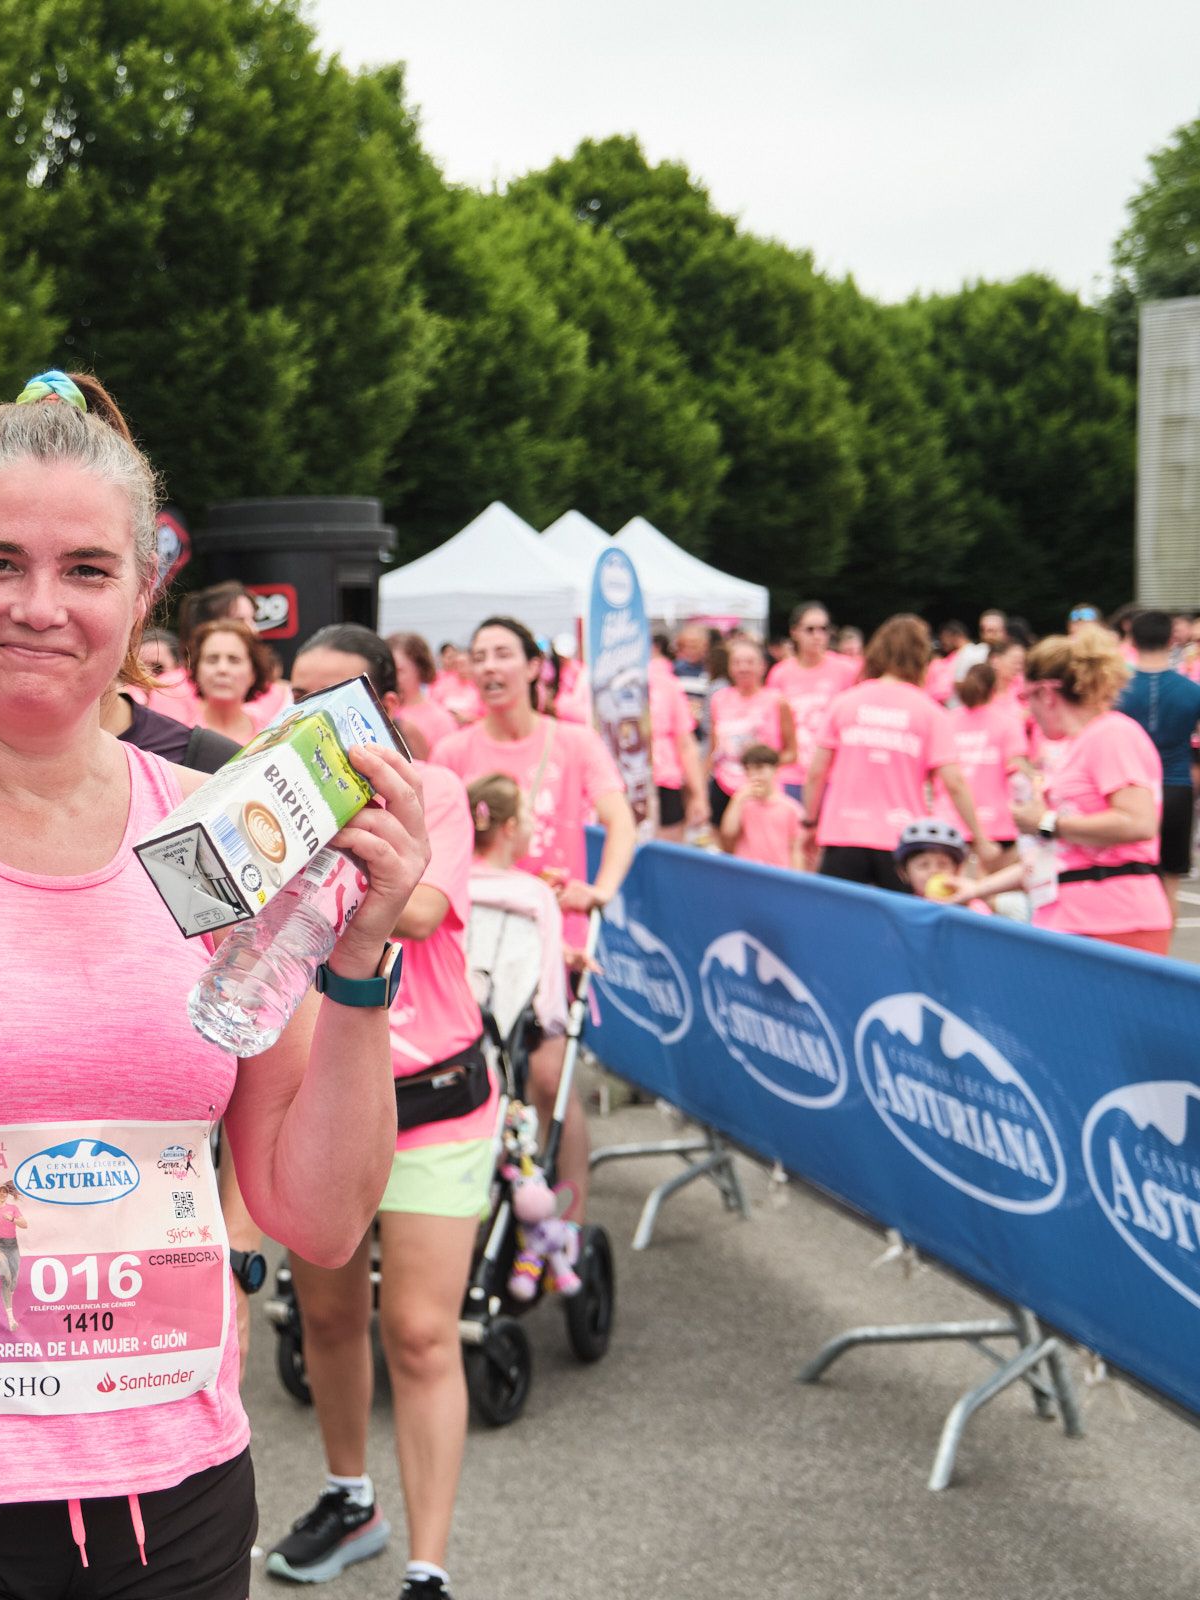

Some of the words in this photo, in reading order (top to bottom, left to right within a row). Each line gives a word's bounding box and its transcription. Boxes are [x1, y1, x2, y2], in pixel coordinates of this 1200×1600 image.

[351, 713, 367, 748] ASTUR
[264, 764, 319, 856] BARISTA
[294, 781, 316, 816] LECHE
[603, 951, 684, 1020] ASTURANA
[713, 976, 837, 1085] ASTURIANA
[872, 1041, 1054, 1187] ASTURIANA
[25, 1165, 134, 1190] ASTURIANA
[46, 1162, 90, 1170] CENTRAL
[148, 1251, 220, 1266] CORREDORA
[30, 1254, 143, 1303] 016
[30, 1304, 65, 1312] TELÉFONO
[66, 1303, 100, 1311] VIOLENCIA
[111, 1301, 136, 1309] GÉNERO
[63, 1311, 114, 1333] 1410
[47, 1341, 66, 1357] DE
[71, 1341, 89, 1356] LA
[93, 1337, 139, 1355] MUJER
[151, 1330, 187, 1350] GIJÓN
[119, 1368, 195, 1391] Santander
